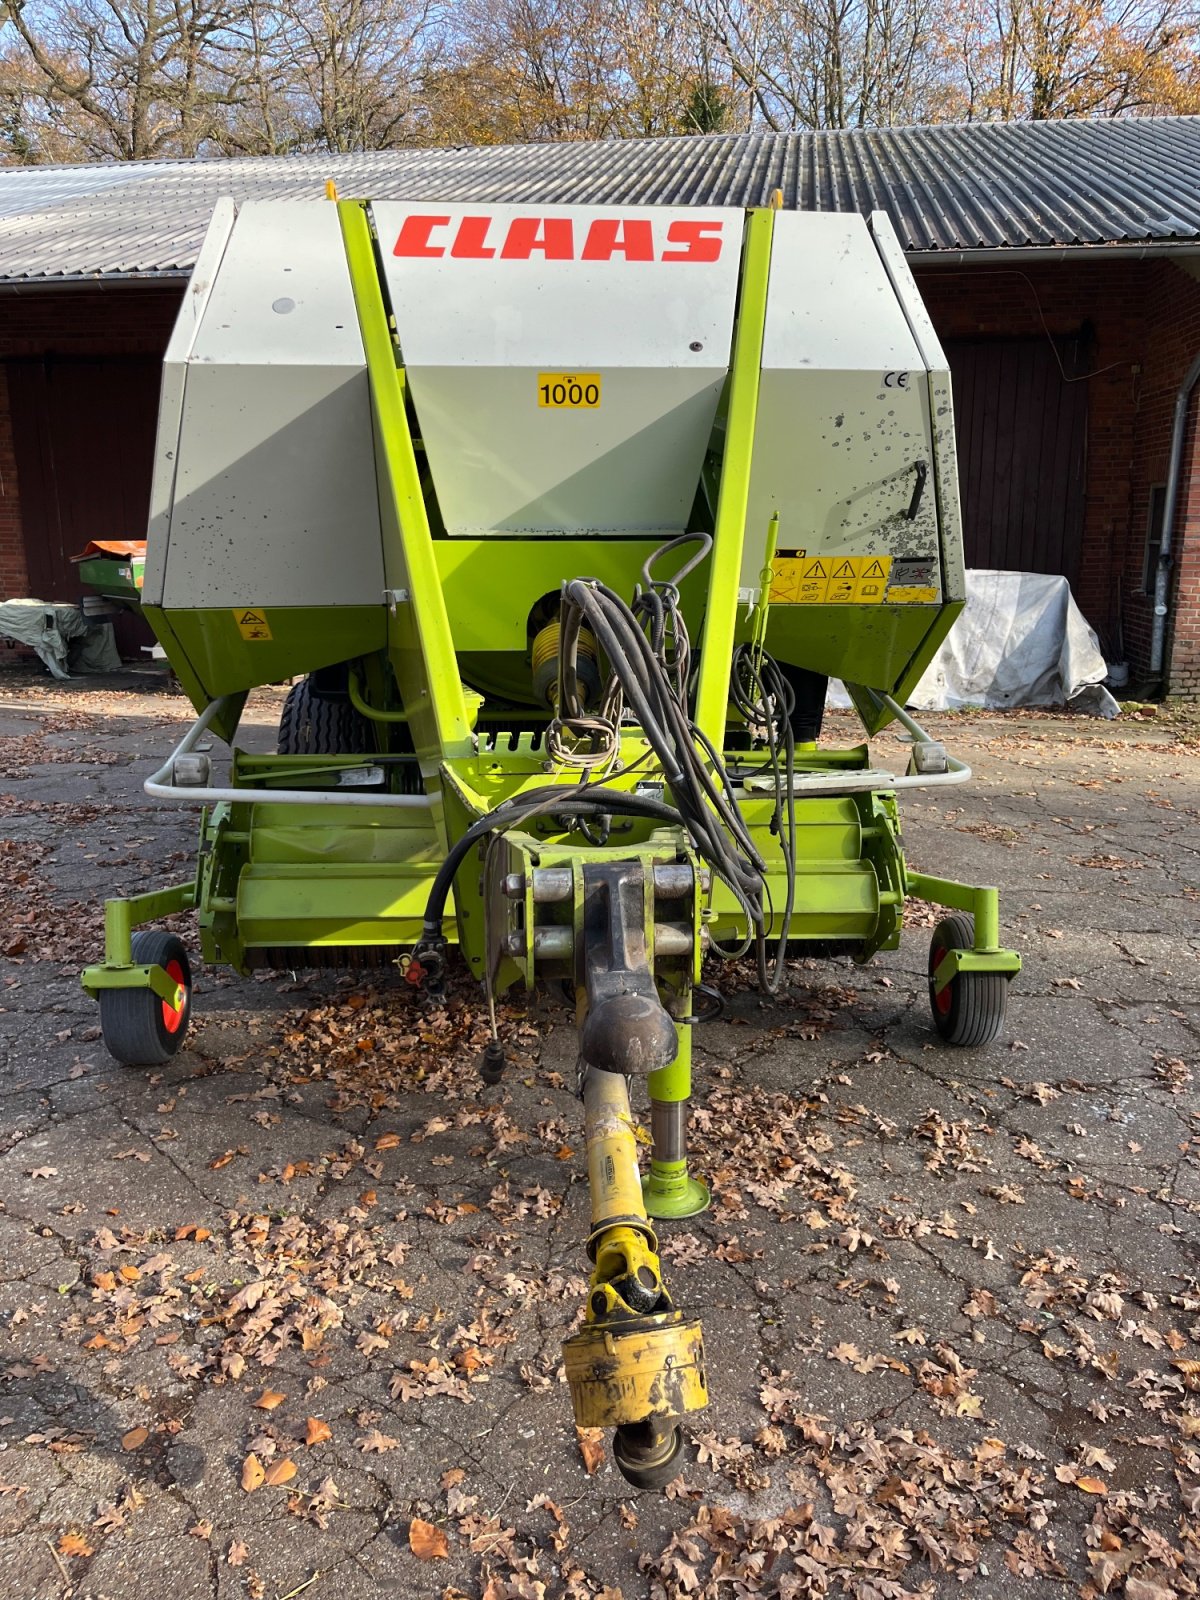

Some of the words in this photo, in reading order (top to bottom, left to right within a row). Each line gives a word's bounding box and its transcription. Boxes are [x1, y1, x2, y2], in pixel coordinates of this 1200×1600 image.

[393, 215, 723, 262] CLAAS
[884, 371, 908, 388] CE
[540, 384, 599, 404] 1000
